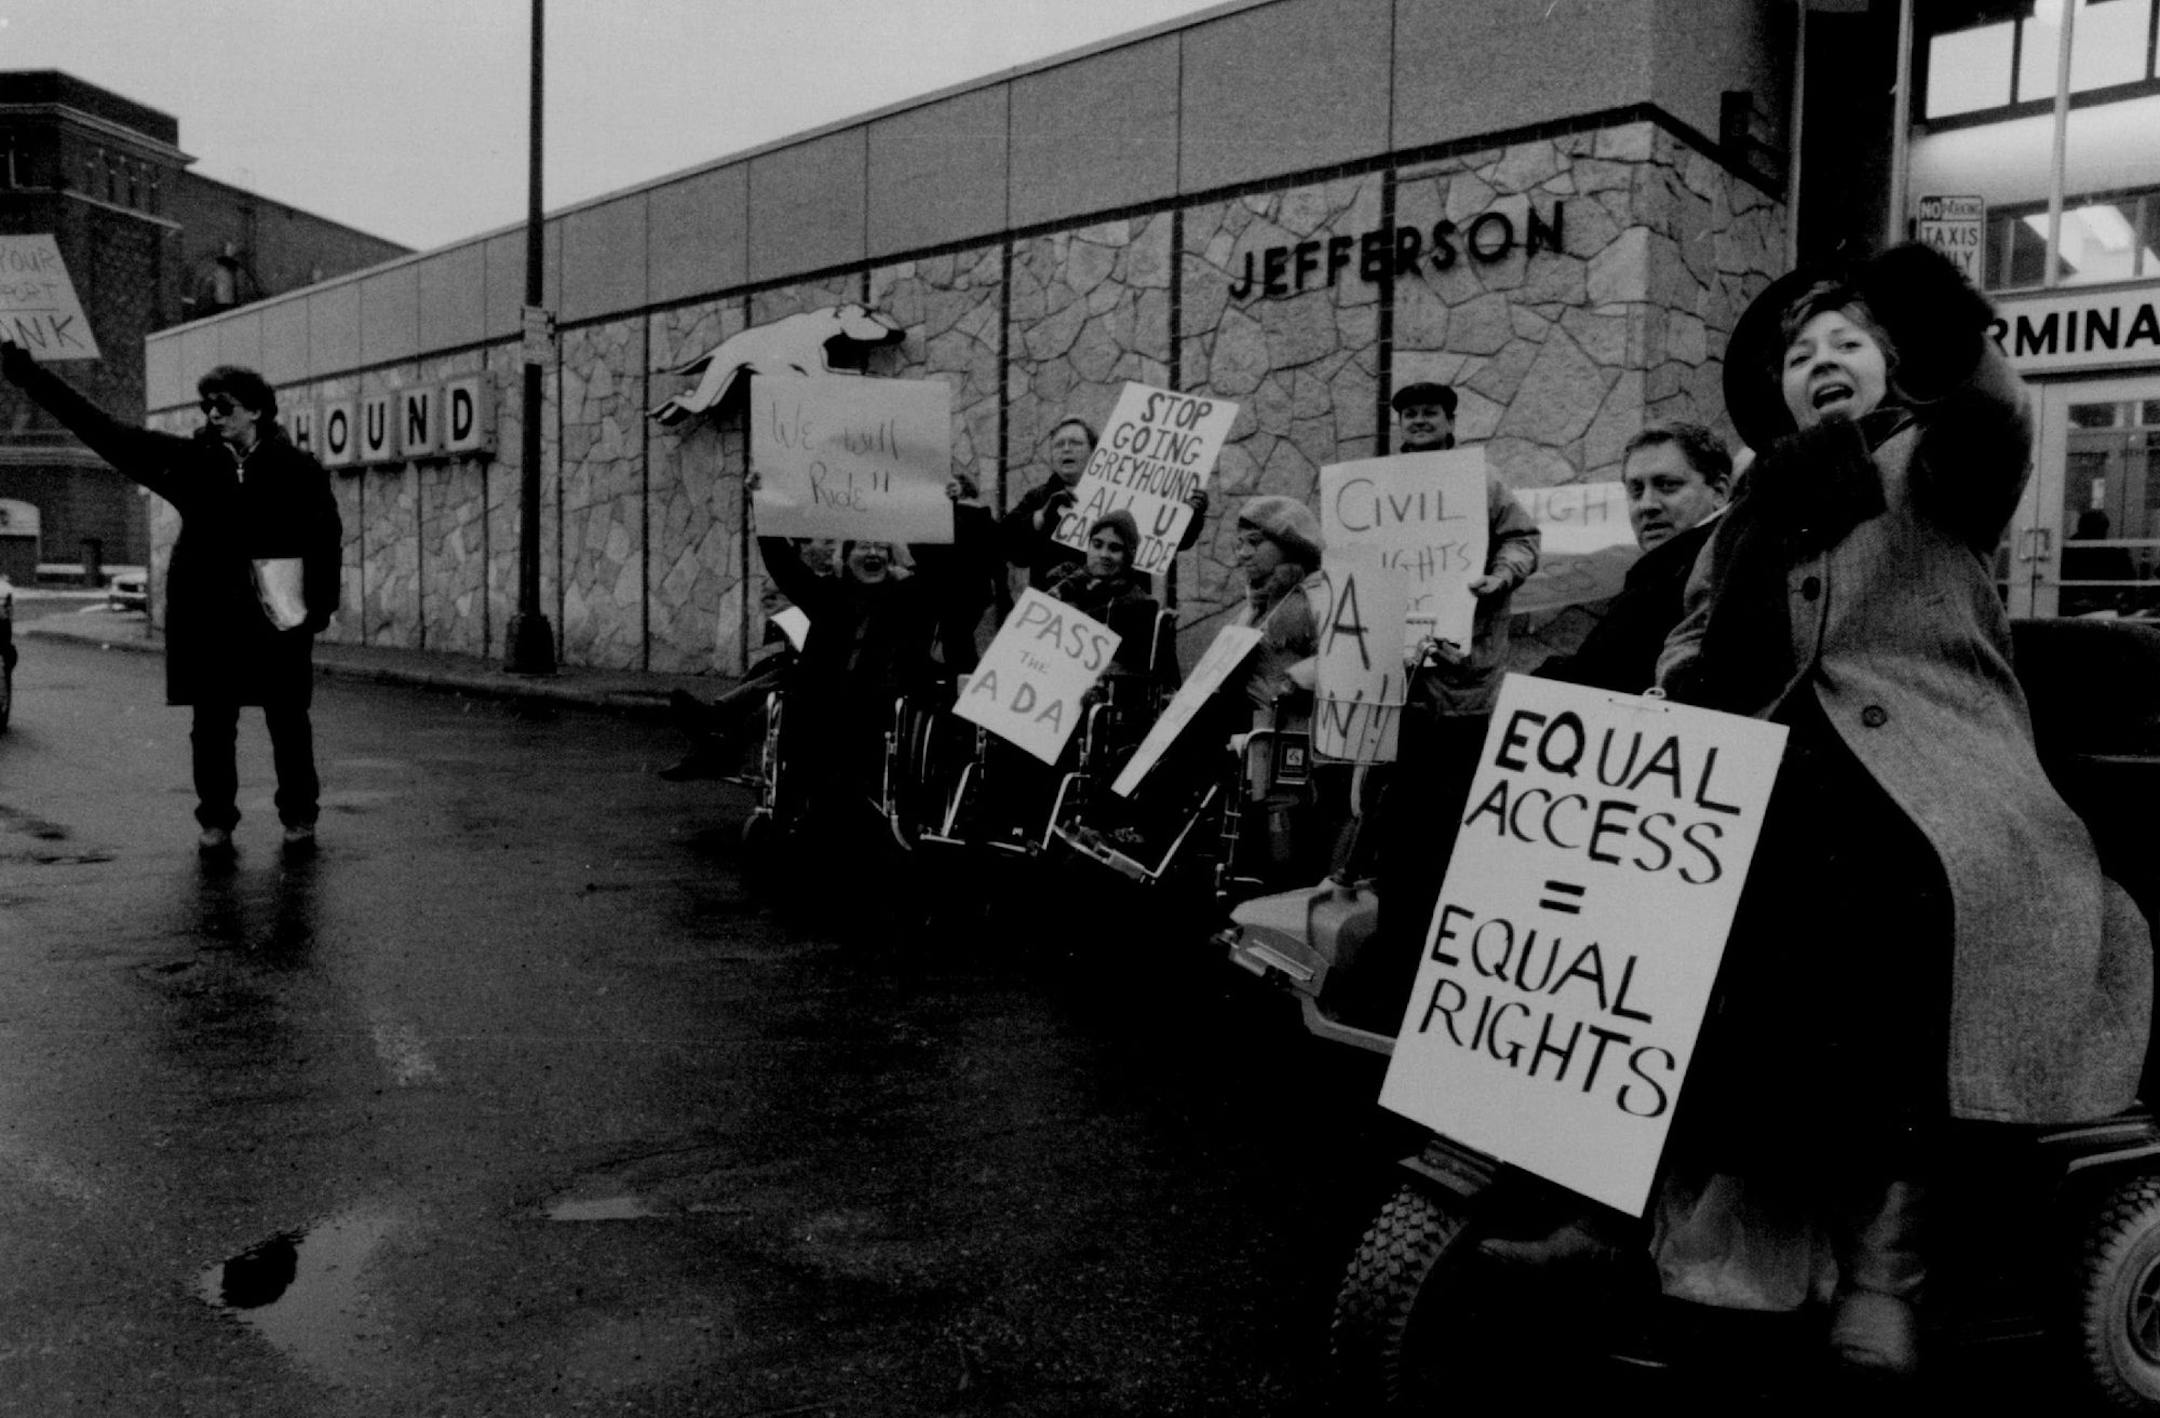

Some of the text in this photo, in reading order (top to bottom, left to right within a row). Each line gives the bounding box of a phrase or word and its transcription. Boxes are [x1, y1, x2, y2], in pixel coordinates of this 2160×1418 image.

[1229, 200, 1563, 299] JEFFERSON
[1924, 227, 1977, 246] TAXIS
[1141, 392, 1213, 431] STOP
[1087, 447, 1200, 502] GREYHOUND
[1113, 422, 1203, 466] GOING
[1153, 504, 1178, 537] U
[1014, 600, 1110, 671] PASS
[1019, 651, 1048, 676] THE
[1495, 711, 1741, 816] EQUAL
[1465, 779, 1724, 885] ACCESS
[1431, 903, 1654, 1024] EQUAL
[1418, 978, 1676, 1118] RIGHTS
